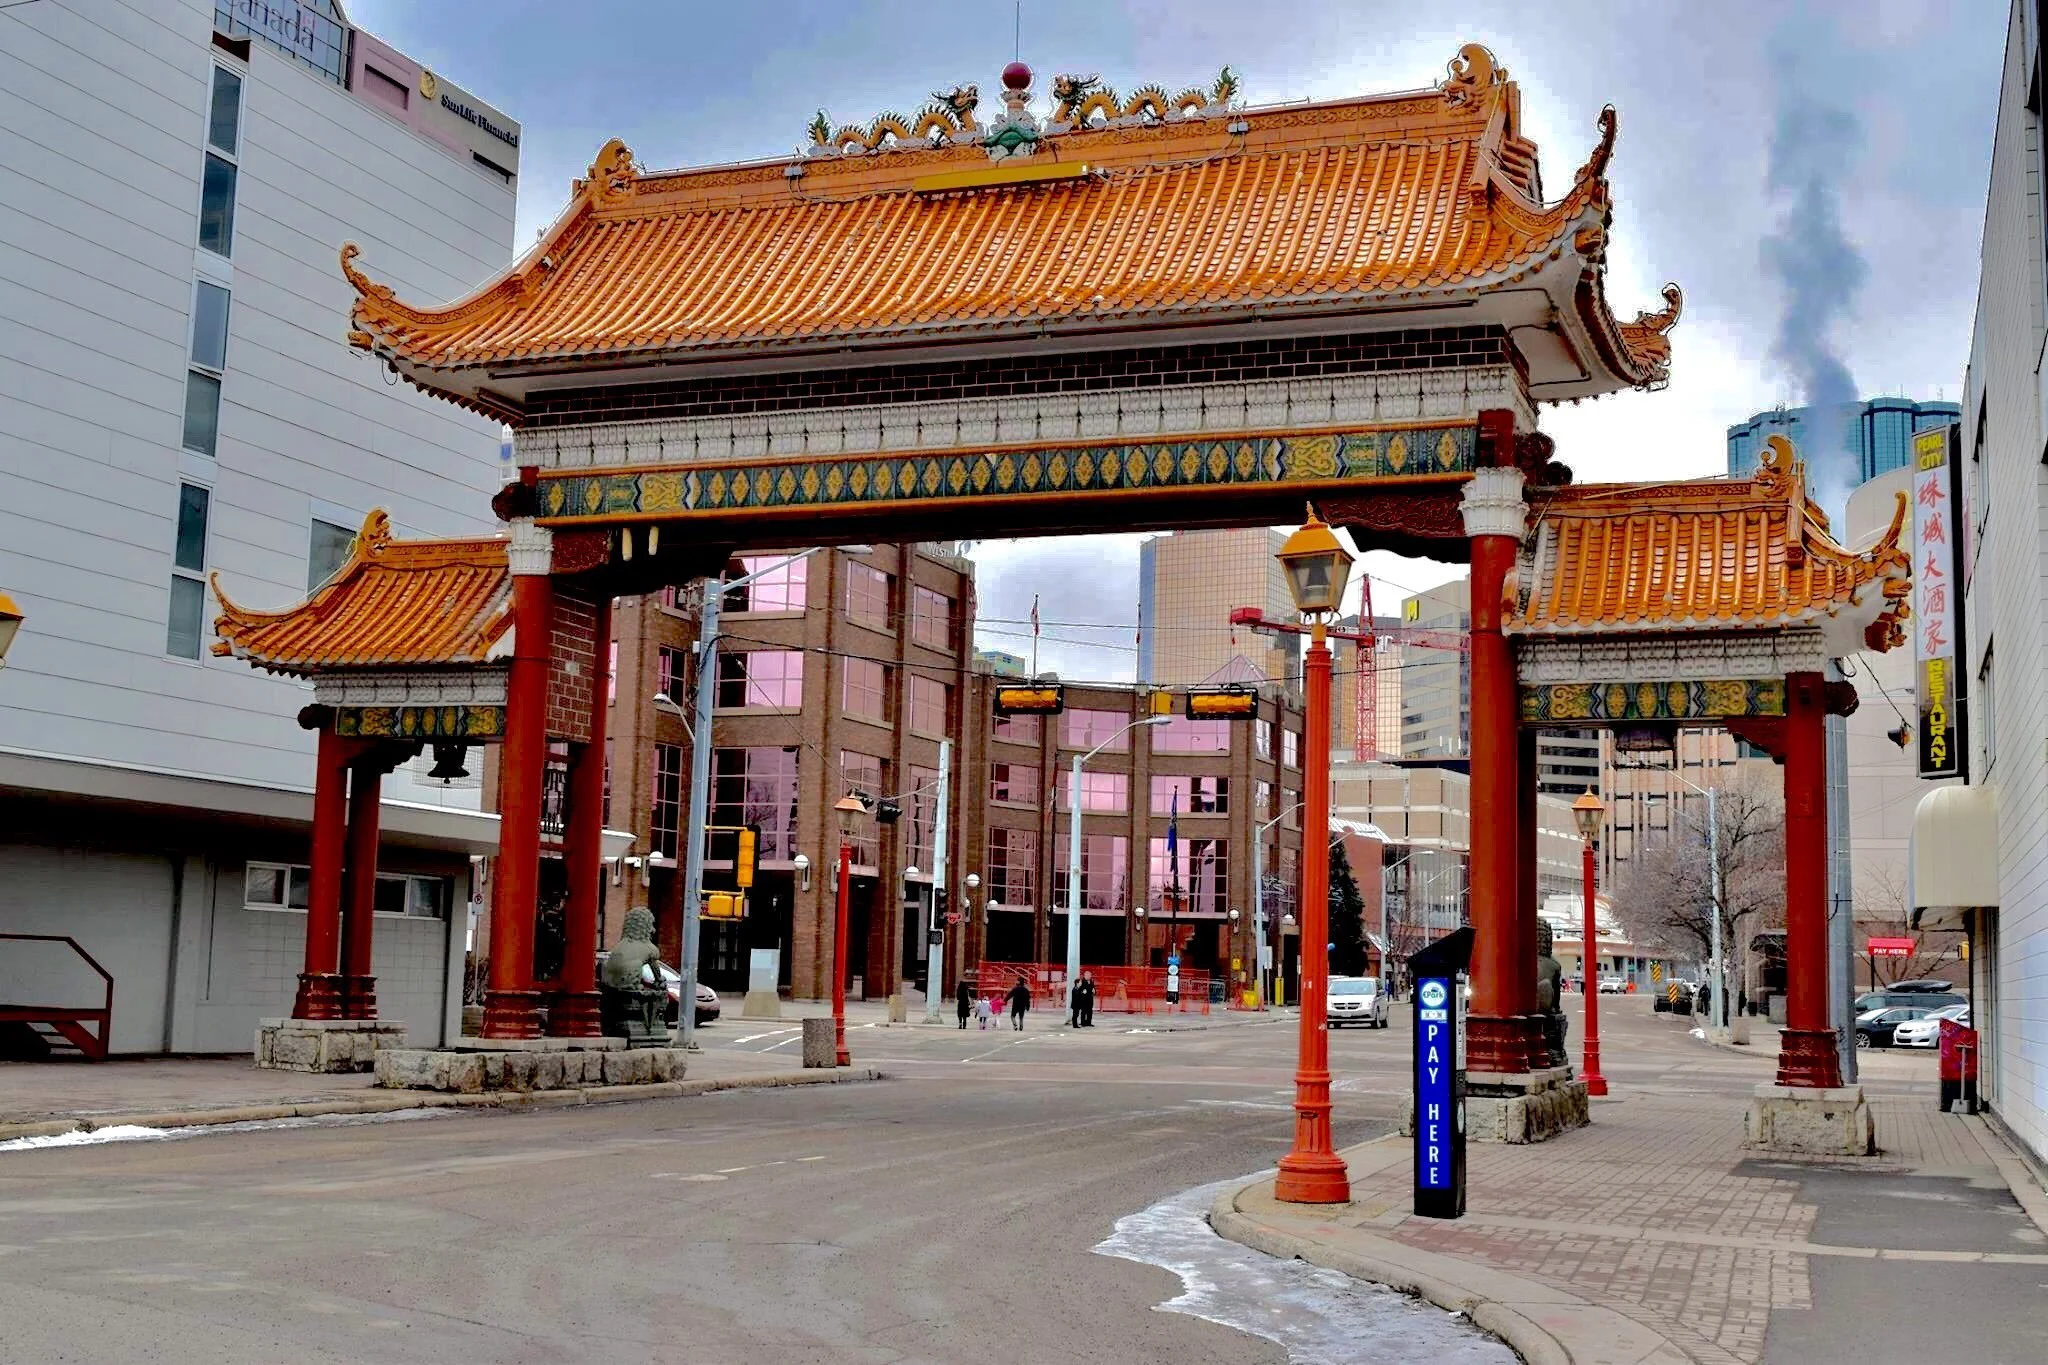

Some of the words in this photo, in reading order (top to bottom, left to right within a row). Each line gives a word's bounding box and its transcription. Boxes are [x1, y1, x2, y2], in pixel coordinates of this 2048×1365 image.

[441, 94, 459, 115] Sun
[459, 104, 476, 125] Life
[478, 114, 518, 148] Financial
[1917, 433, 1943, 451] PEARL
[1920, 452, 1944, 470] CITY
[1918, 472, 1947, 656] 珠城大酒家
[1927, 659, 1946, 768] RESTAURANT
[1428, 1024, 1439, 1084] PAY
[1428, 1103, 1439, 1184] HERE
